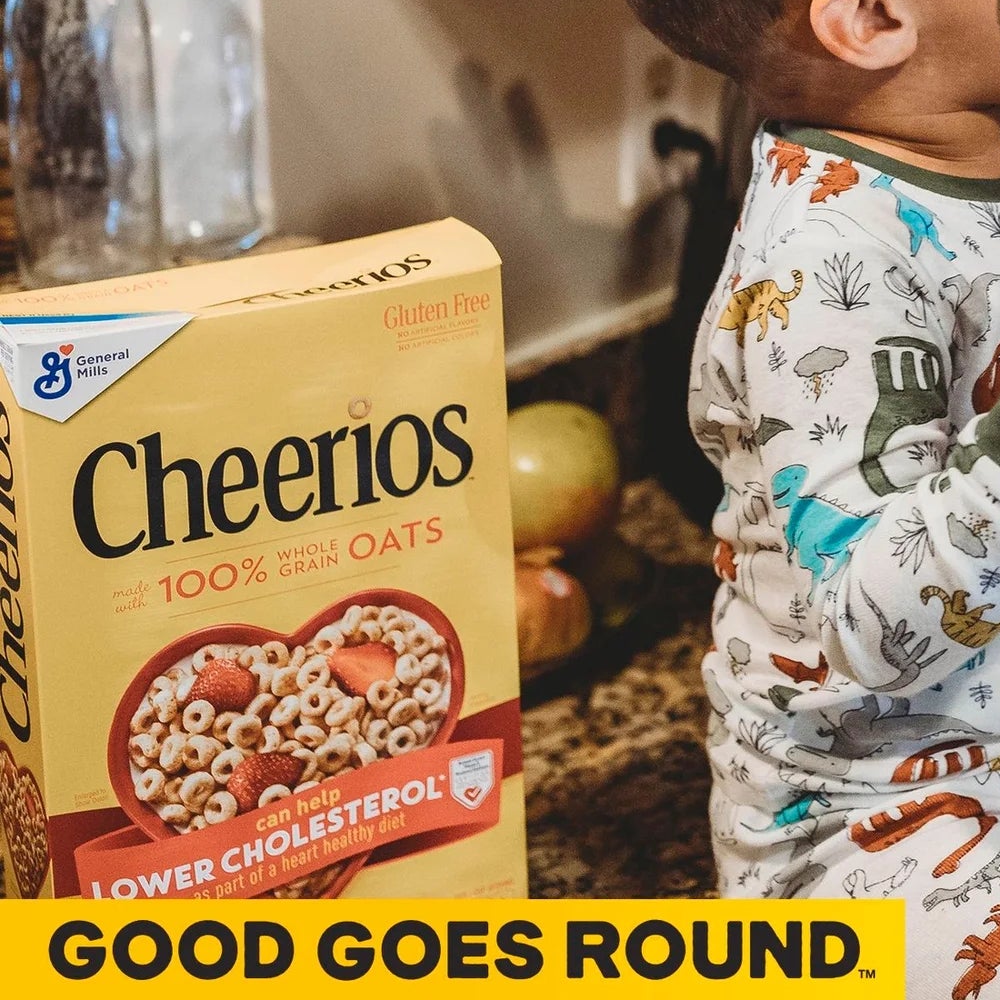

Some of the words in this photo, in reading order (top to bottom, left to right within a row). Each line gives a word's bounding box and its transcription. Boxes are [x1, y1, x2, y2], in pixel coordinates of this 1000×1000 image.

[384, 301, 448, 330] Gluten
[453, 292, 490, 316] Free
[398, 331, 409, 339] NO
[76, 348, 130, 366] General
[398, 343, 410, 352] NO
[77, 366, 108, 379] Mills
[72, 397, 474, 560] Cheerios
[158, 555, 267, 603] 100%
[349, 517, 444, 561] OATS
[277, 539, 339, 562] WHOLE
[279, 554, 339, 577] GRAIN
[112, 581, 151, 600] made
[113, 594, 147, 614] with
[256, 807, 291, 832] can
[297, 788, 341, 817] help
[215, 873, 244, 899] part
[250, 865, 264, 885] of
[268, 862, 277, 877] a
[281, 847, 319, 872] heart
[323, 824, 375, 855] healthy
[378, 812, 406, 835] diet
[91, 858, 217, 899] LOWER
